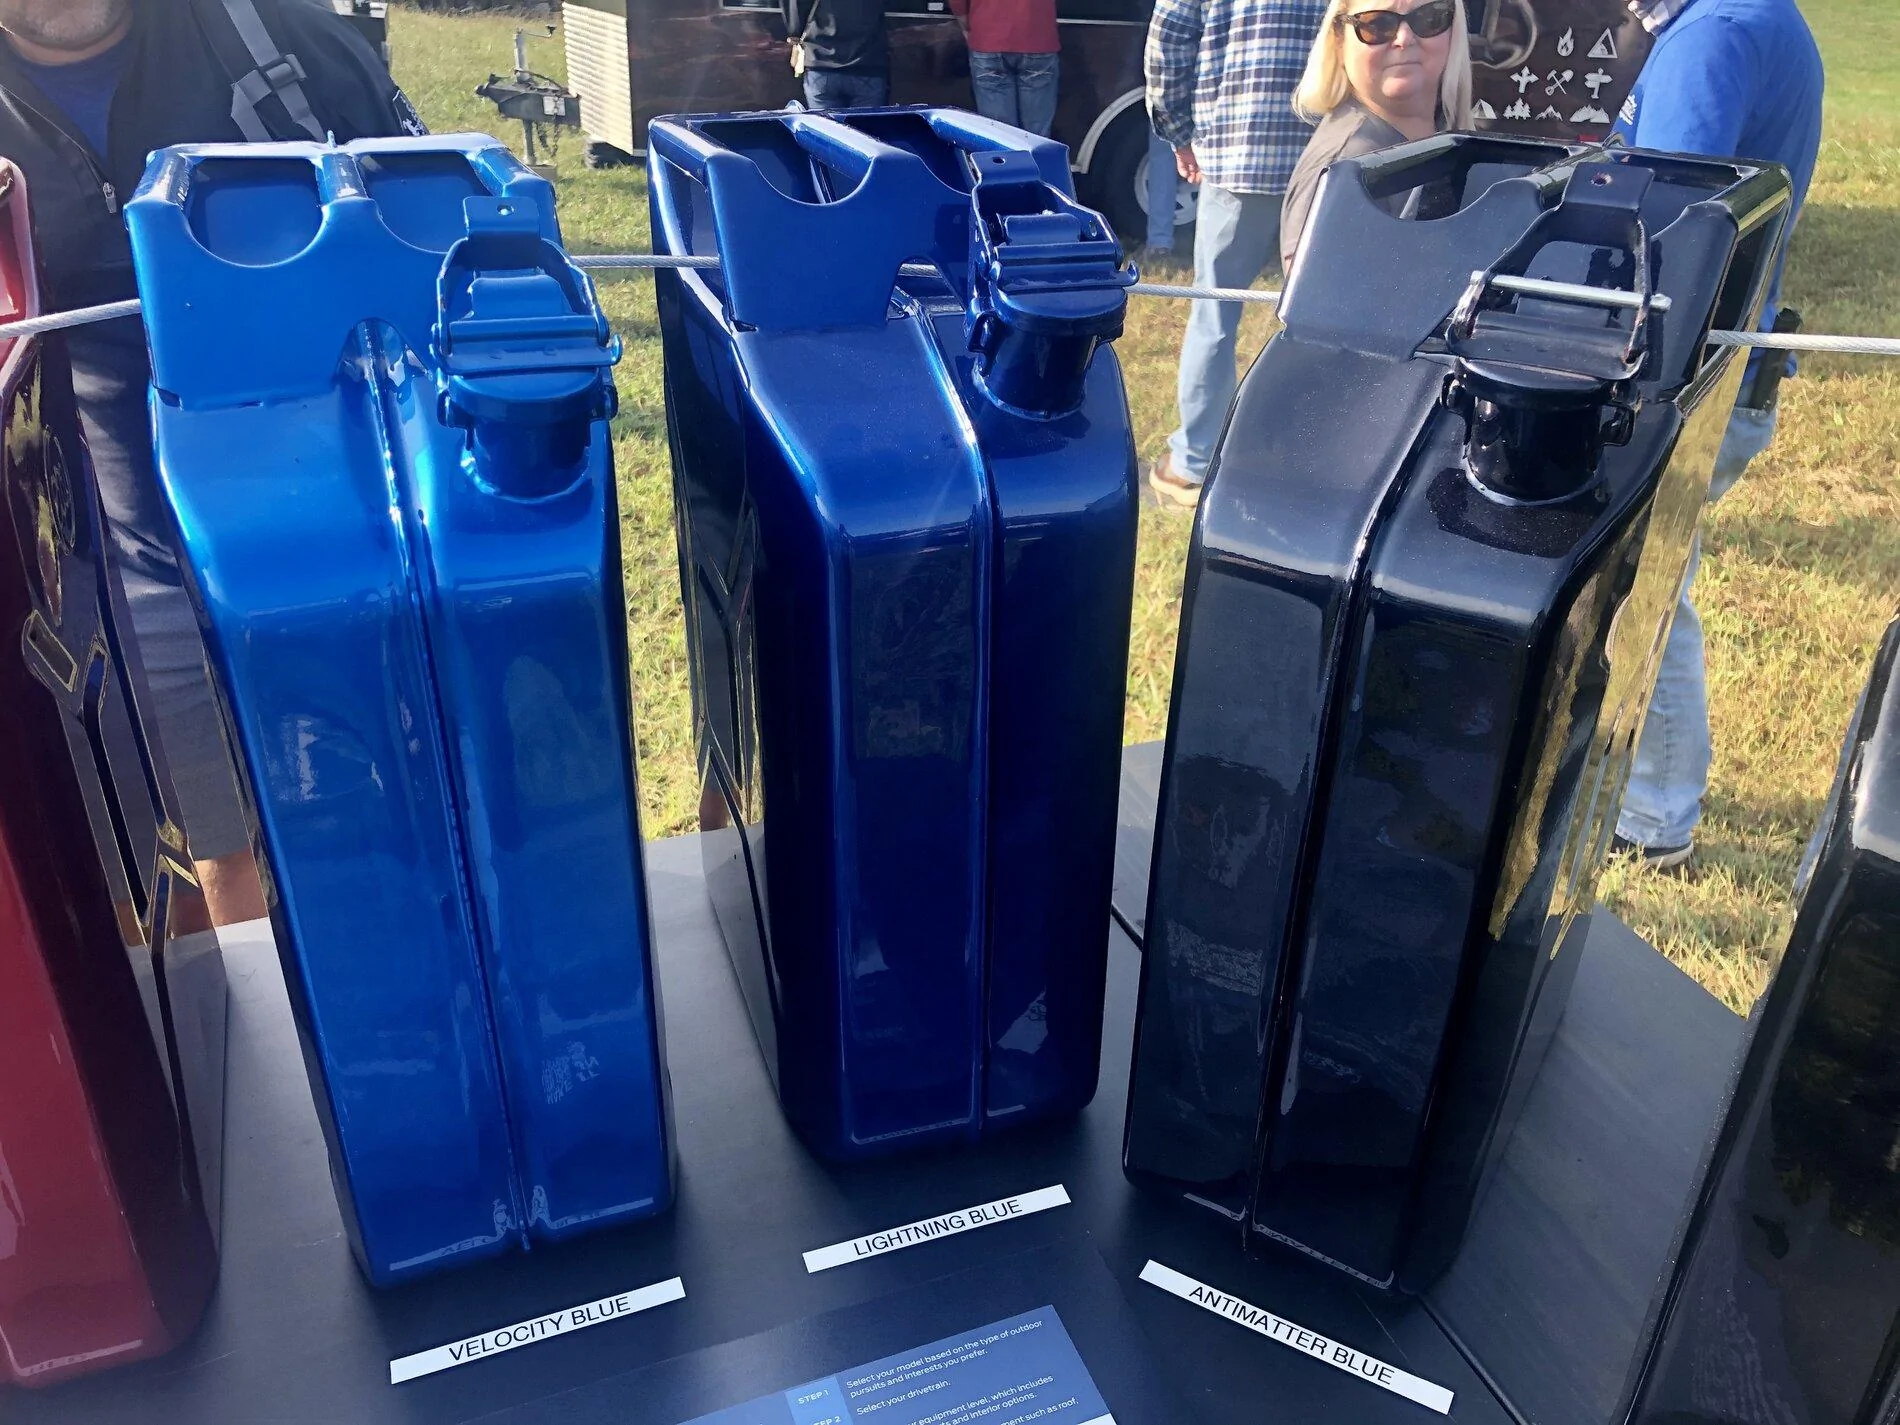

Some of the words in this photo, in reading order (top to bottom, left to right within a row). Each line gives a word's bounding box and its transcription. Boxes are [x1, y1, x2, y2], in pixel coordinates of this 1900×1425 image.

[854, 1215, 965, 1255] LIGHTNING
[969, 1199, 1022, 1224] BLUE
[449, 1315, 563, 1360] VELOCITY
[572, 1296, 631, 1325] BLUE
[1189, 1286, 1326, 1354] ANTIMATTER
[1333, 1347, 1395, 1385] BLUE
[846, 1374, 876, 1389] Select
[876, 1369, 895, 1380] your
[896, 1358, 924, 1373] model
[924, 1348, 952, 1363] based
[952, 1346, 964, 1355] on
[964, 1341, 979, 1350] the
[979, 1334, 999, 1346] type
[1000, 1330, 1010, 1339] of
[1009, 1320, 1043, 1336] outdoor
[850, 1381, 886, 1398] pursuits
[887, 1375, 904, 1386] and
[904, 1362, 943, 1380] interests
[943, 1357, 960, 1368] you
[960, 1348, 988, 1363] prefer.
[798, 1391, 824, 1404] STEP
[856, 1400, 886, 1415] Select
[887, 1394, 906, 1406] your
[918, 1404, 966, 1425] equipment
[967, 1396, 990, 1410] level,
[991, 1386, 1017, 1402] which
[1017, 1374, 1054, 1393] includes
[952, 1413, 969, 1425] and
[970, 1403, 1001, 1419] interior
[1002, 1392, 1037, 1408] options.
[1025, 1409, 1045, 1421] such
[1046, 1406, 1058, 1414] as
